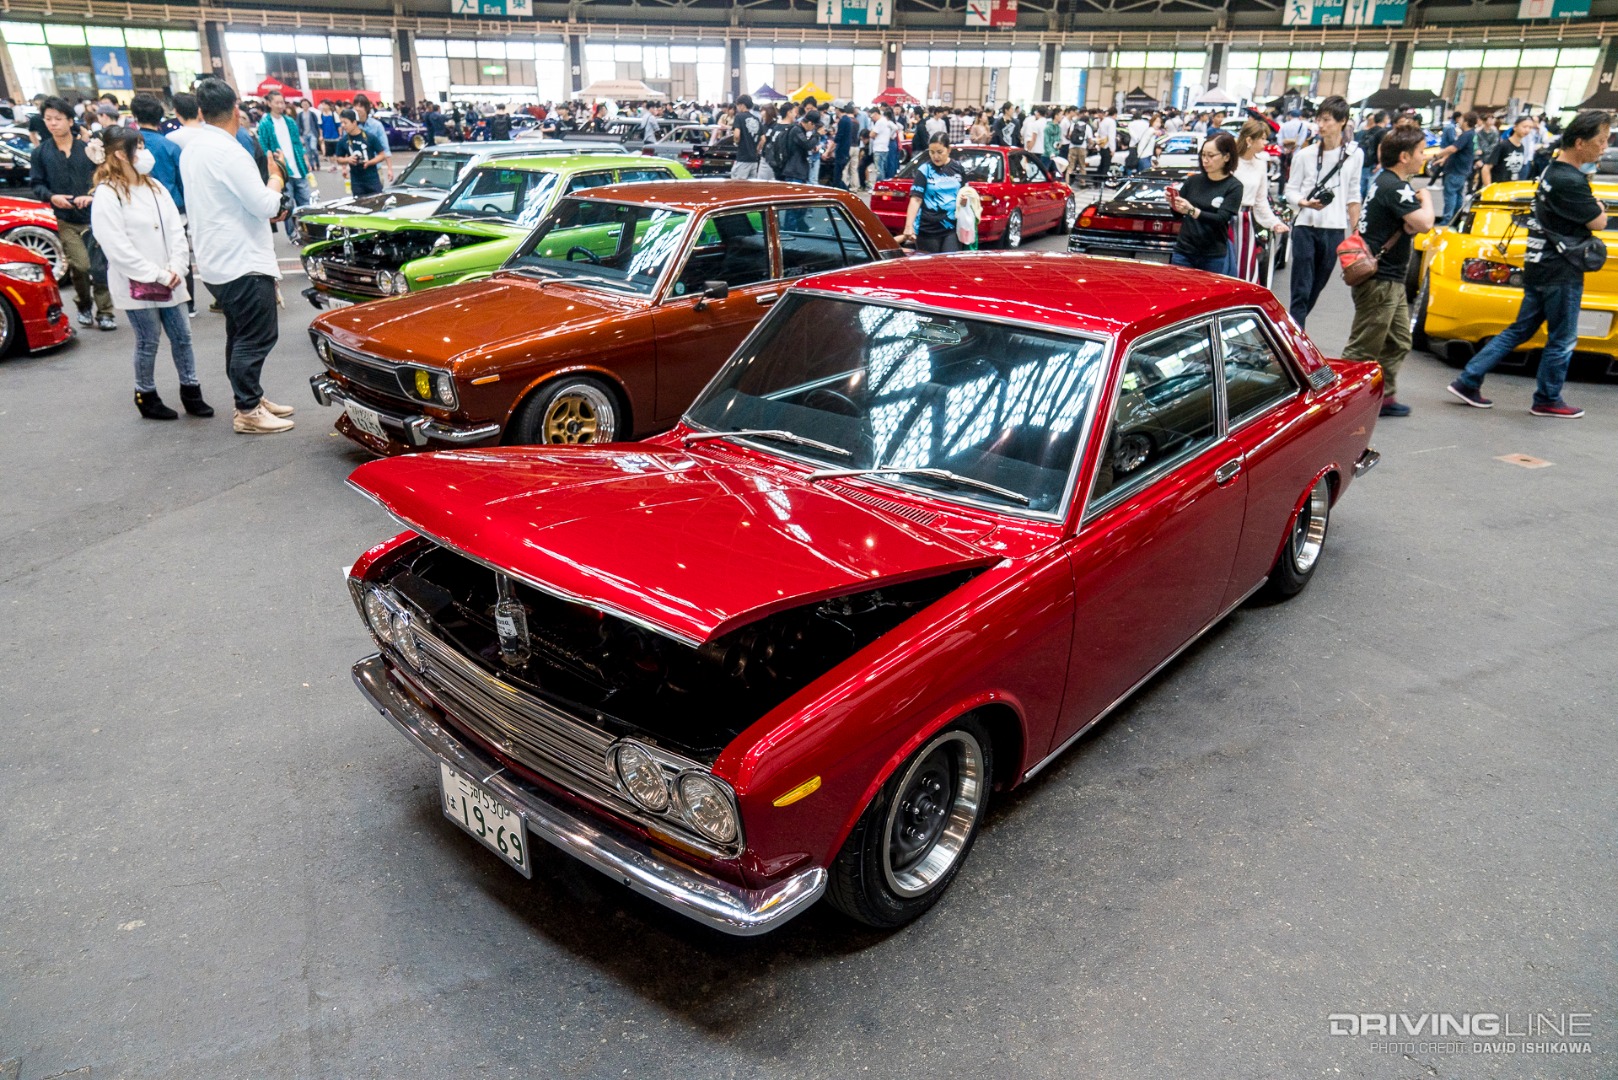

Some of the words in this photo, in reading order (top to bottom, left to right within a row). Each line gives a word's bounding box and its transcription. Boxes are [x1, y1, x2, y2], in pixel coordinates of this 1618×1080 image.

[483, 4, 501, 15] Exit
[1322, 14, 1341, 25] Exit
[402, 62, 411, 72] 27
[1600, 73, 1613, 84] 34
[461, 796, 524, 866] 19-69
